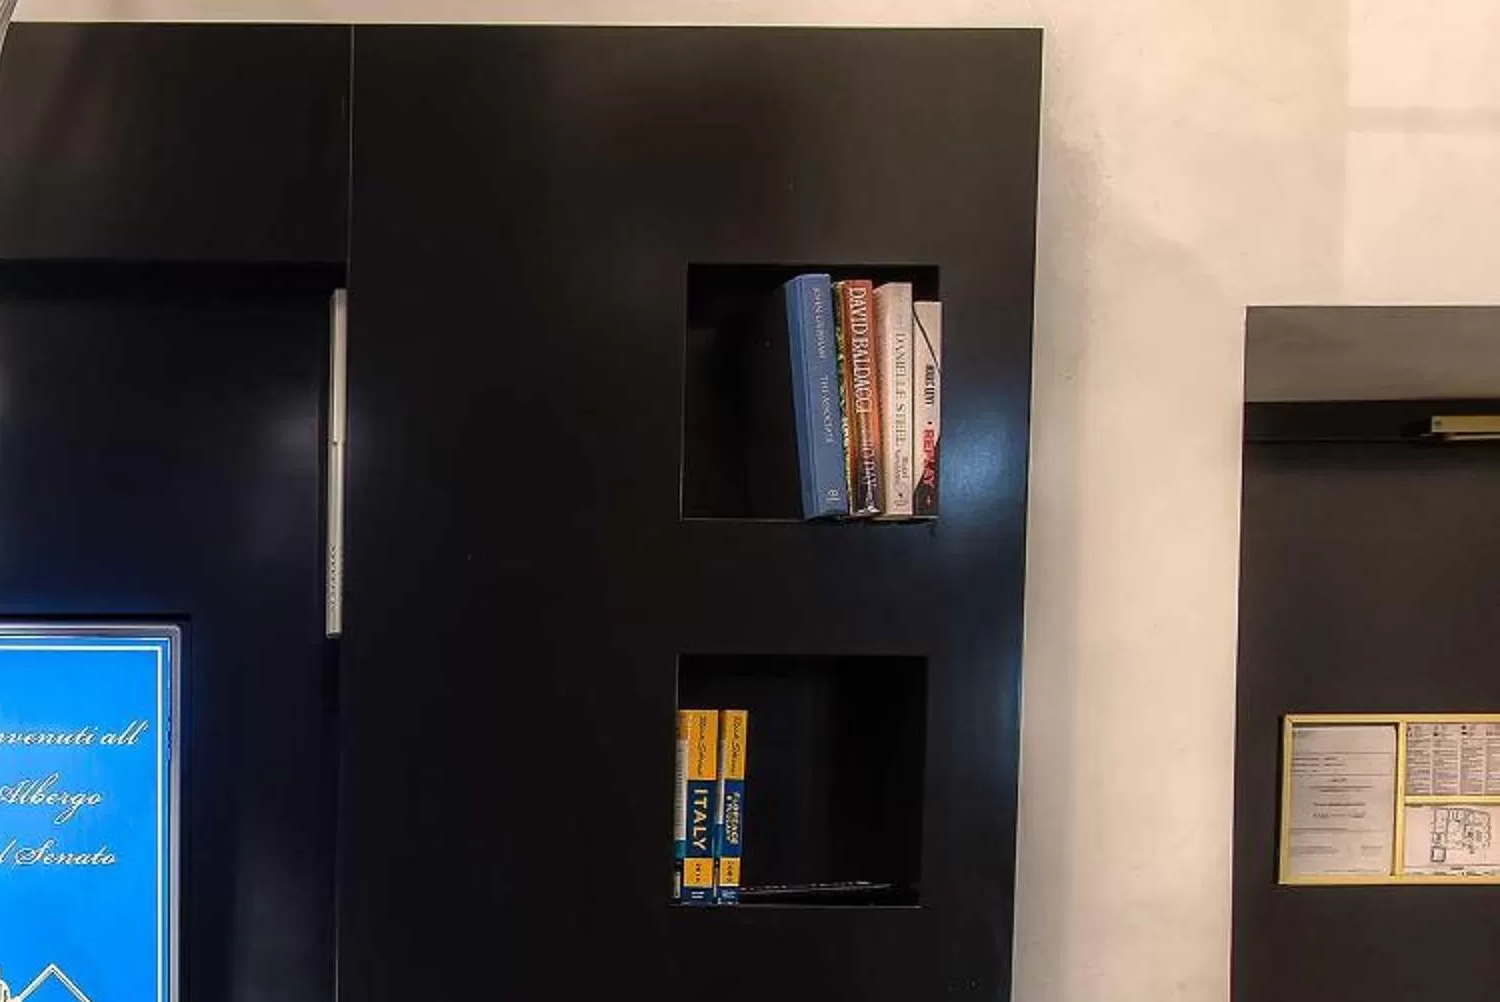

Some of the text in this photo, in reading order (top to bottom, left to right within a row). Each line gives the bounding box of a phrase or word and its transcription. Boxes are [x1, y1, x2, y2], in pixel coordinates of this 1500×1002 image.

[850, 287, 869, 334] DAVID
[852, 337, 873, 414] BALDACCI
[894, 333, 907, 397] DANIELLE
[895, 403, 908, 446] STEEL
[692, 788, 709, 851] ITALY
[15, 839, 117, 866] Senato
